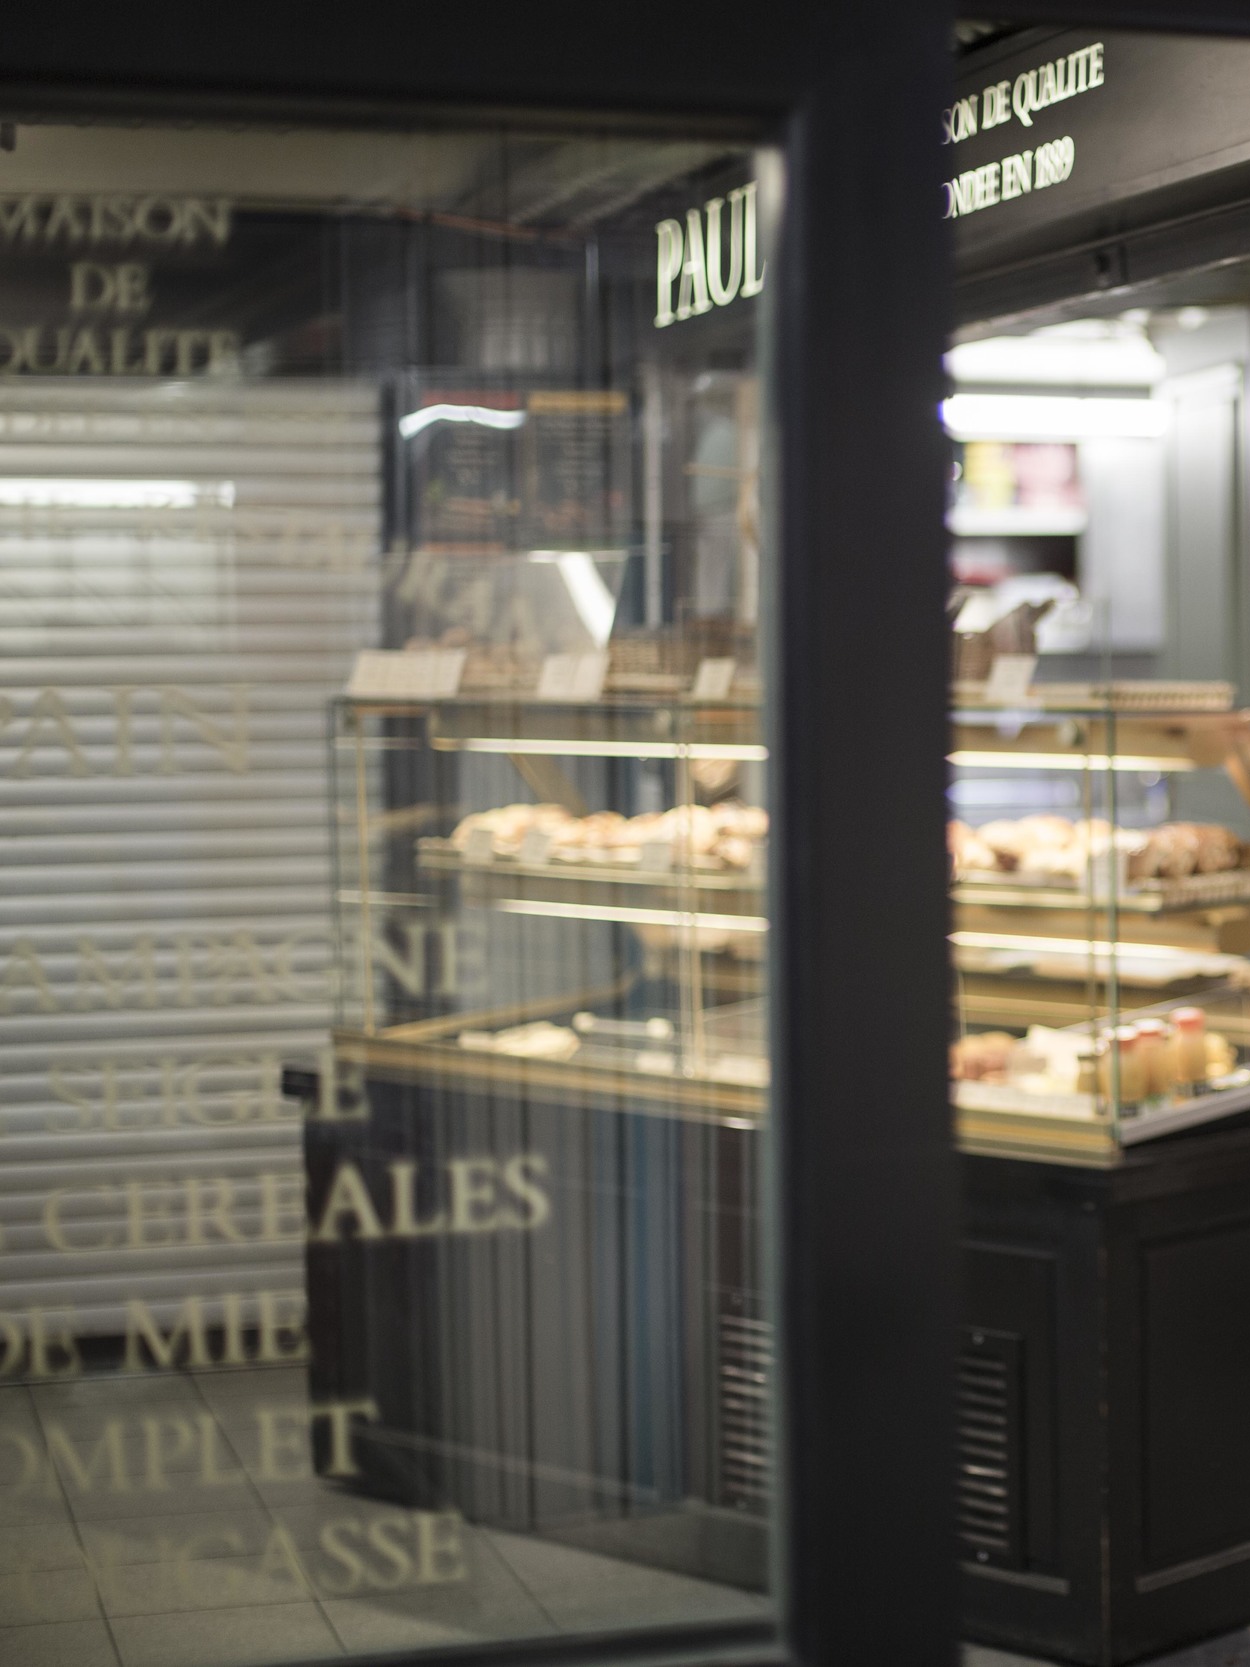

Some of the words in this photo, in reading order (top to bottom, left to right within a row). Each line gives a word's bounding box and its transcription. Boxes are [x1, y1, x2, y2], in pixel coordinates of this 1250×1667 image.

[981, 79, 1012, 130] DE
[1012, 42, 1105, 127] QUALITE
[1001, 149, 1034, 201] EN
[1034, 135, 1075, 190] 1889
[69, 262, 152, 312] DE
[653, 180, 767, 329] PAUL
[0, 682, 252, 779] AIN
[41, 1152, 552, 1255] CEREALES
[120, 1289, 311, 1372] MIE
